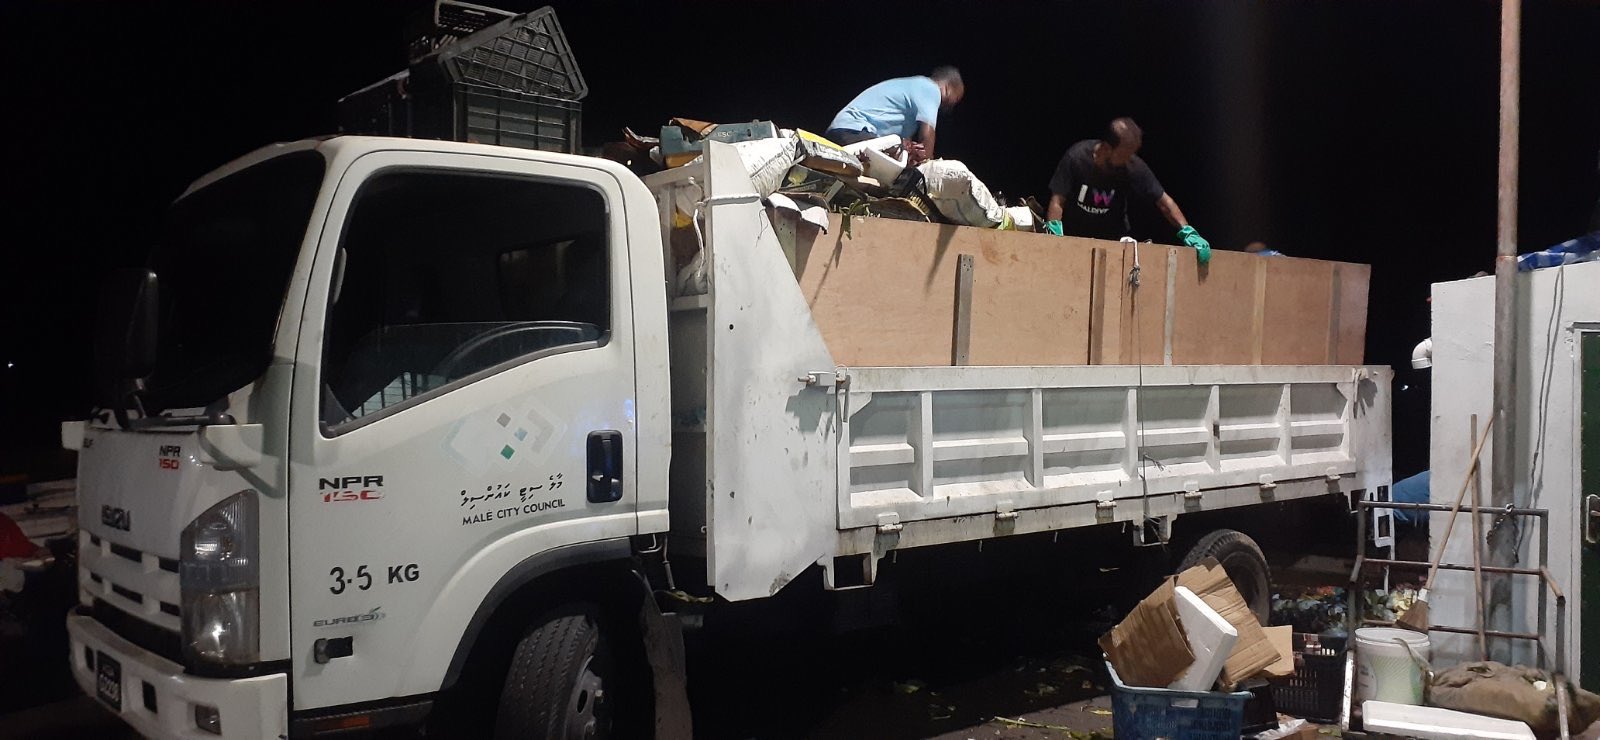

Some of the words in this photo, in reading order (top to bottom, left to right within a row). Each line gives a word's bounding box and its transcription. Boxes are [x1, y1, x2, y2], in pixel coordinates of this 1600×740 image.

[159, 445, 181, 457] NPR
[319, 475, 384, 490] NPR
[496, 507, 520, 519] CITY
[523, 499, 566, 513] COUNCIL
[388, 563, 420, 584] KG
